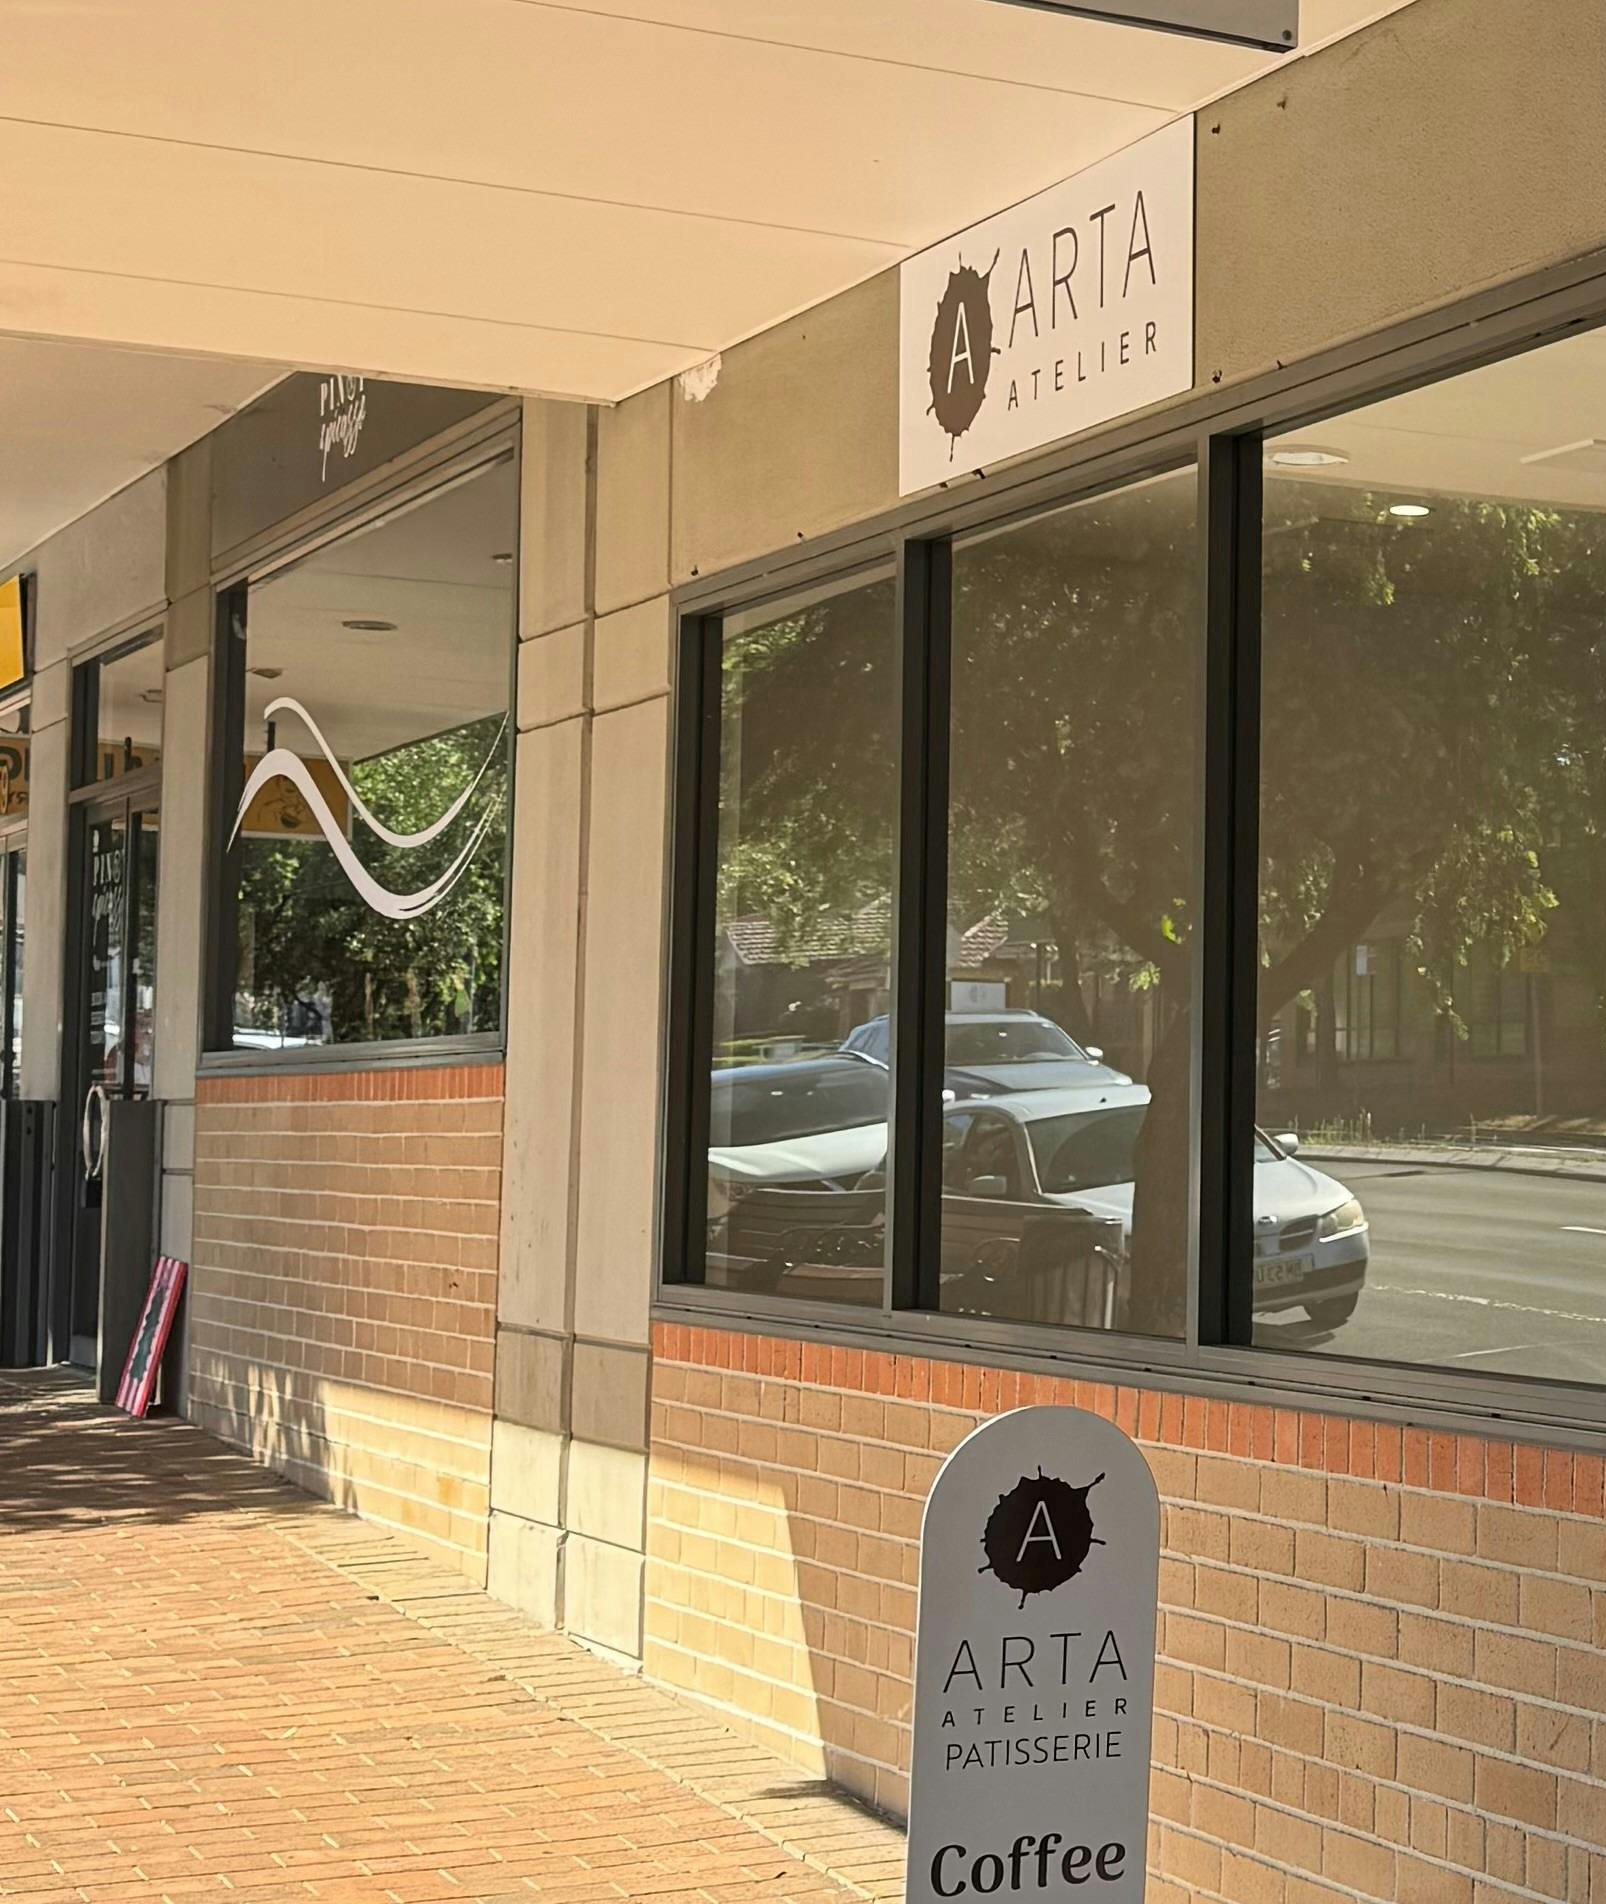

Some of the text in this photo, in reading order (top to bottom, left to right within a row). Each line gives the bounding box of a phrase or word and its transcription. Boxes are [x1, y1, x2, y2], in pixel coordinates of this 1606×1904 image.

[1008, 190, 1156, 349] ARTA
[947, 301, 974, 394] A
[1008, 321, 1157, 411] ATELIER
[1016, 1500, 1062, 1562] A
[943, 1630, 1128, 1694] ARTA
[941, 1697, 1127, 1729] ATELIER
[946, 1731, 1122, 1771] PATISSERIE
[930, 1833, 1126, 1897] Coffee
